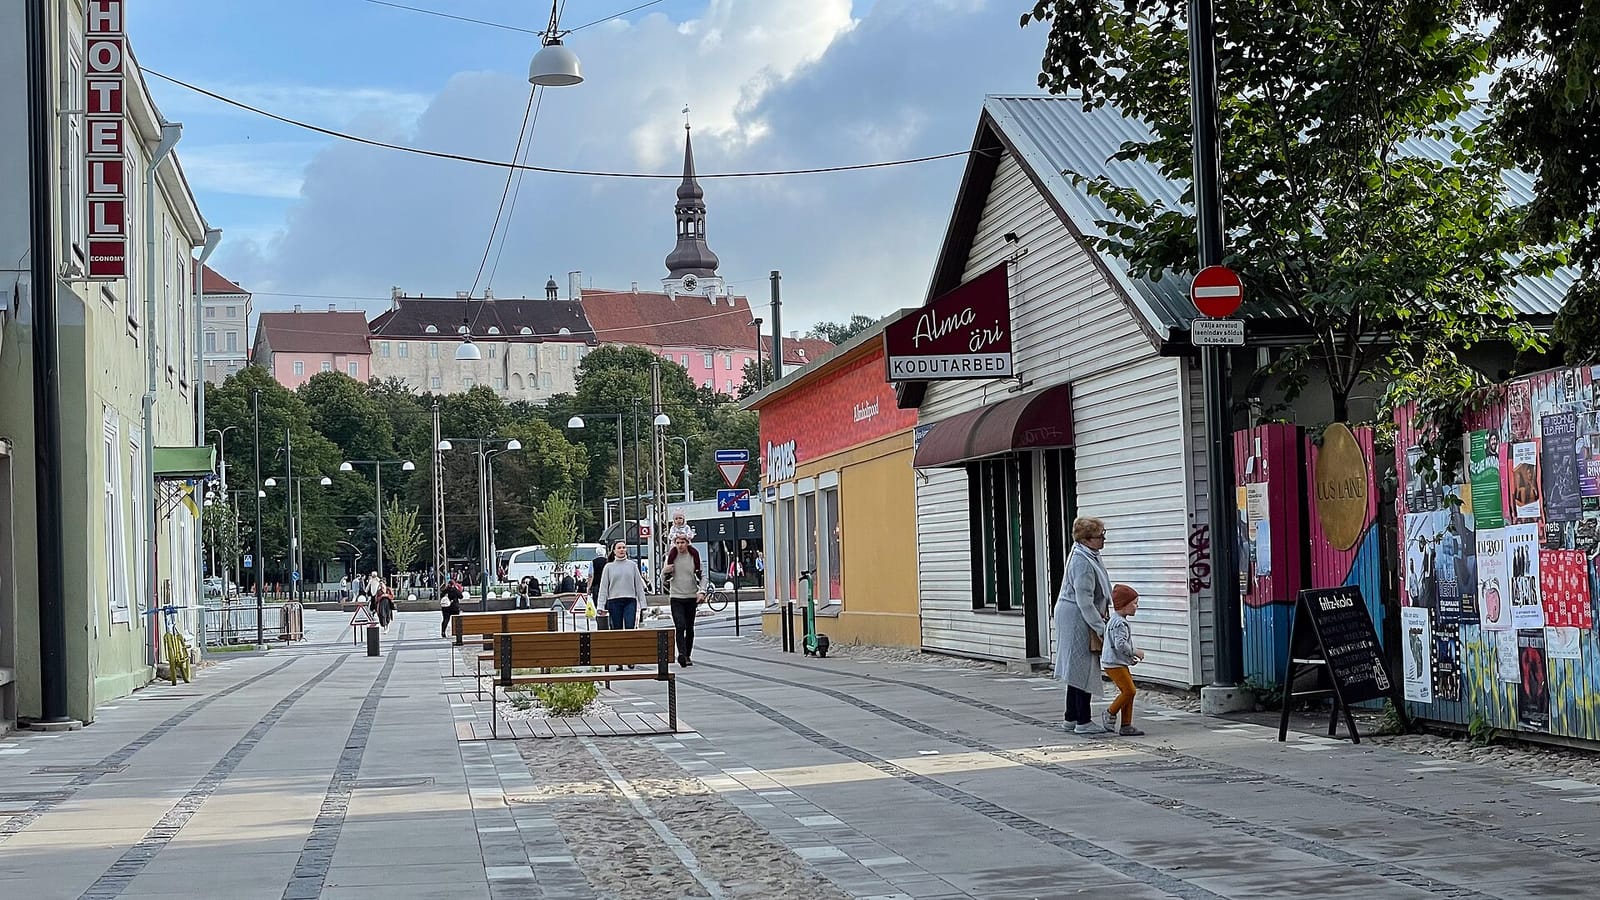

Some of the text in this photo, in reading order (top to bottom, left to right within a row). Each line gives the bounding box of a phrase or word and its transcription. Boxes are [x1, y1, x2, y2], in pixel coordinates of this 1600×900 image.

[89, 1, 121, 232] HOTELL
[912, 307, 976, 348] Alma
[968, 319, 1004, 352] äri
[894, 357, 1005, 374] KODUTARBED
[767, 439, 797, 484] Araxes
[1317, 480, 1336, 500] UUS
[1318, 593, 1353, 611] fritz-kola
